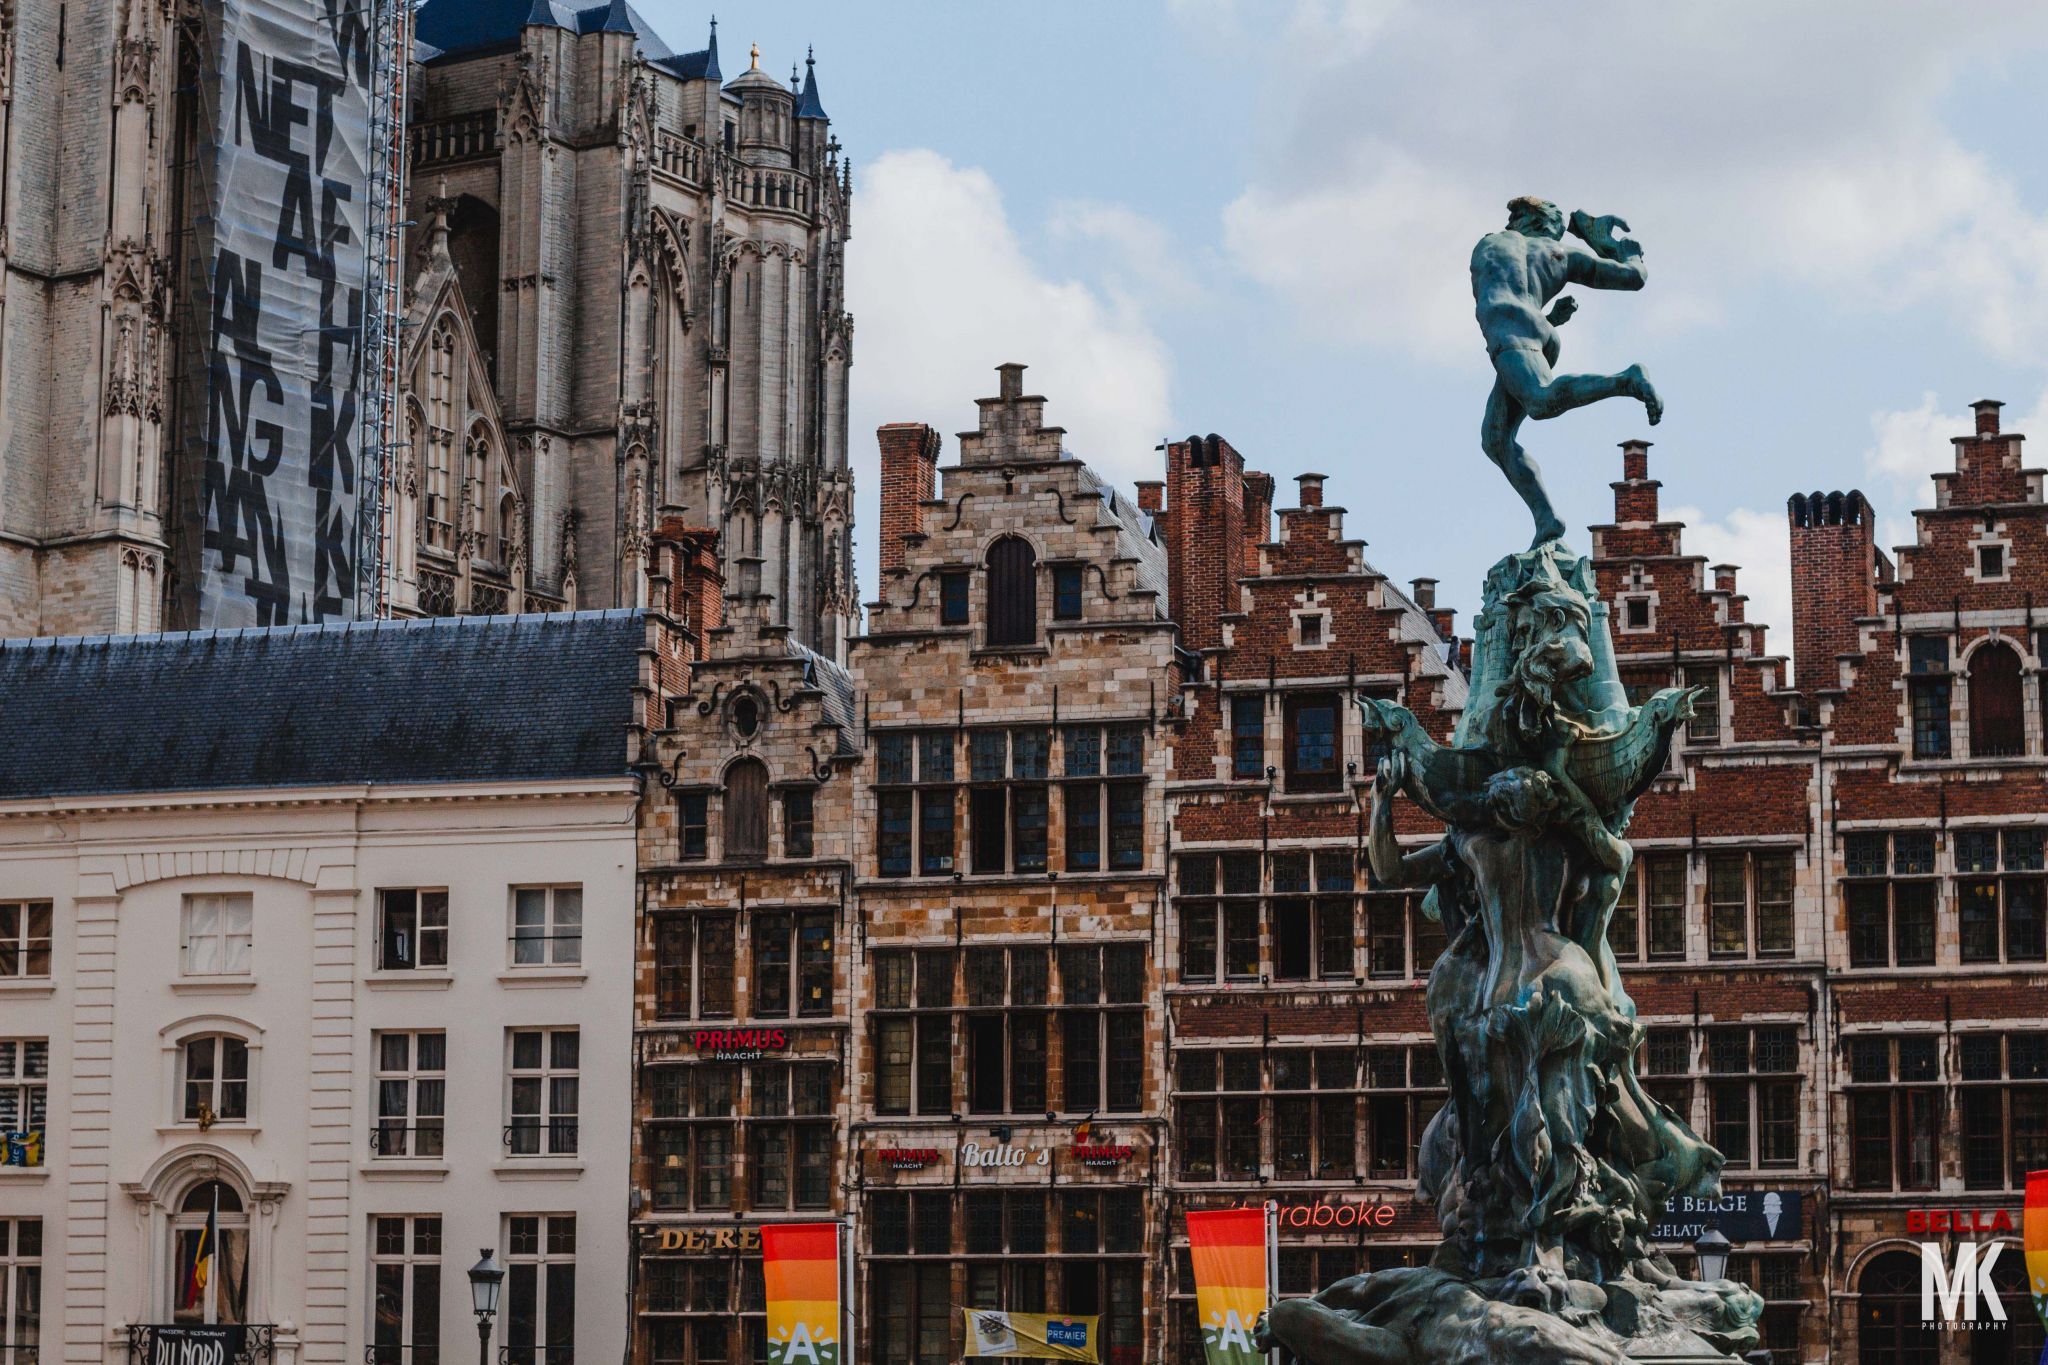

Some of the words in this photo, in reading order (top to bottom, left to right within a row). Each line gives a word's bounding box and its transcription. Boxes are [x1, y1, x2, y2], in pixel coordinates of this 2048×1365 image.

[694, 1029, 785, 1050] PRIMUS
[716, 1052, 762, 1060] HAACHT
[878, 1148, 939, 1165] PRIMUS
[961, 1142, 1050, 1167] Balto's
[1071, 1145, 1133, 1160] PRIMUS
[1085, 1159, 1118, 1167] HAACHT
[1683, 1195, 1748, 1214] BELGE
[1906, 1209, 2014, 1233] BELLA
[660, 1228, 706, 1250] DE
[1047, 1329, 1087, 1341] PREMIER
